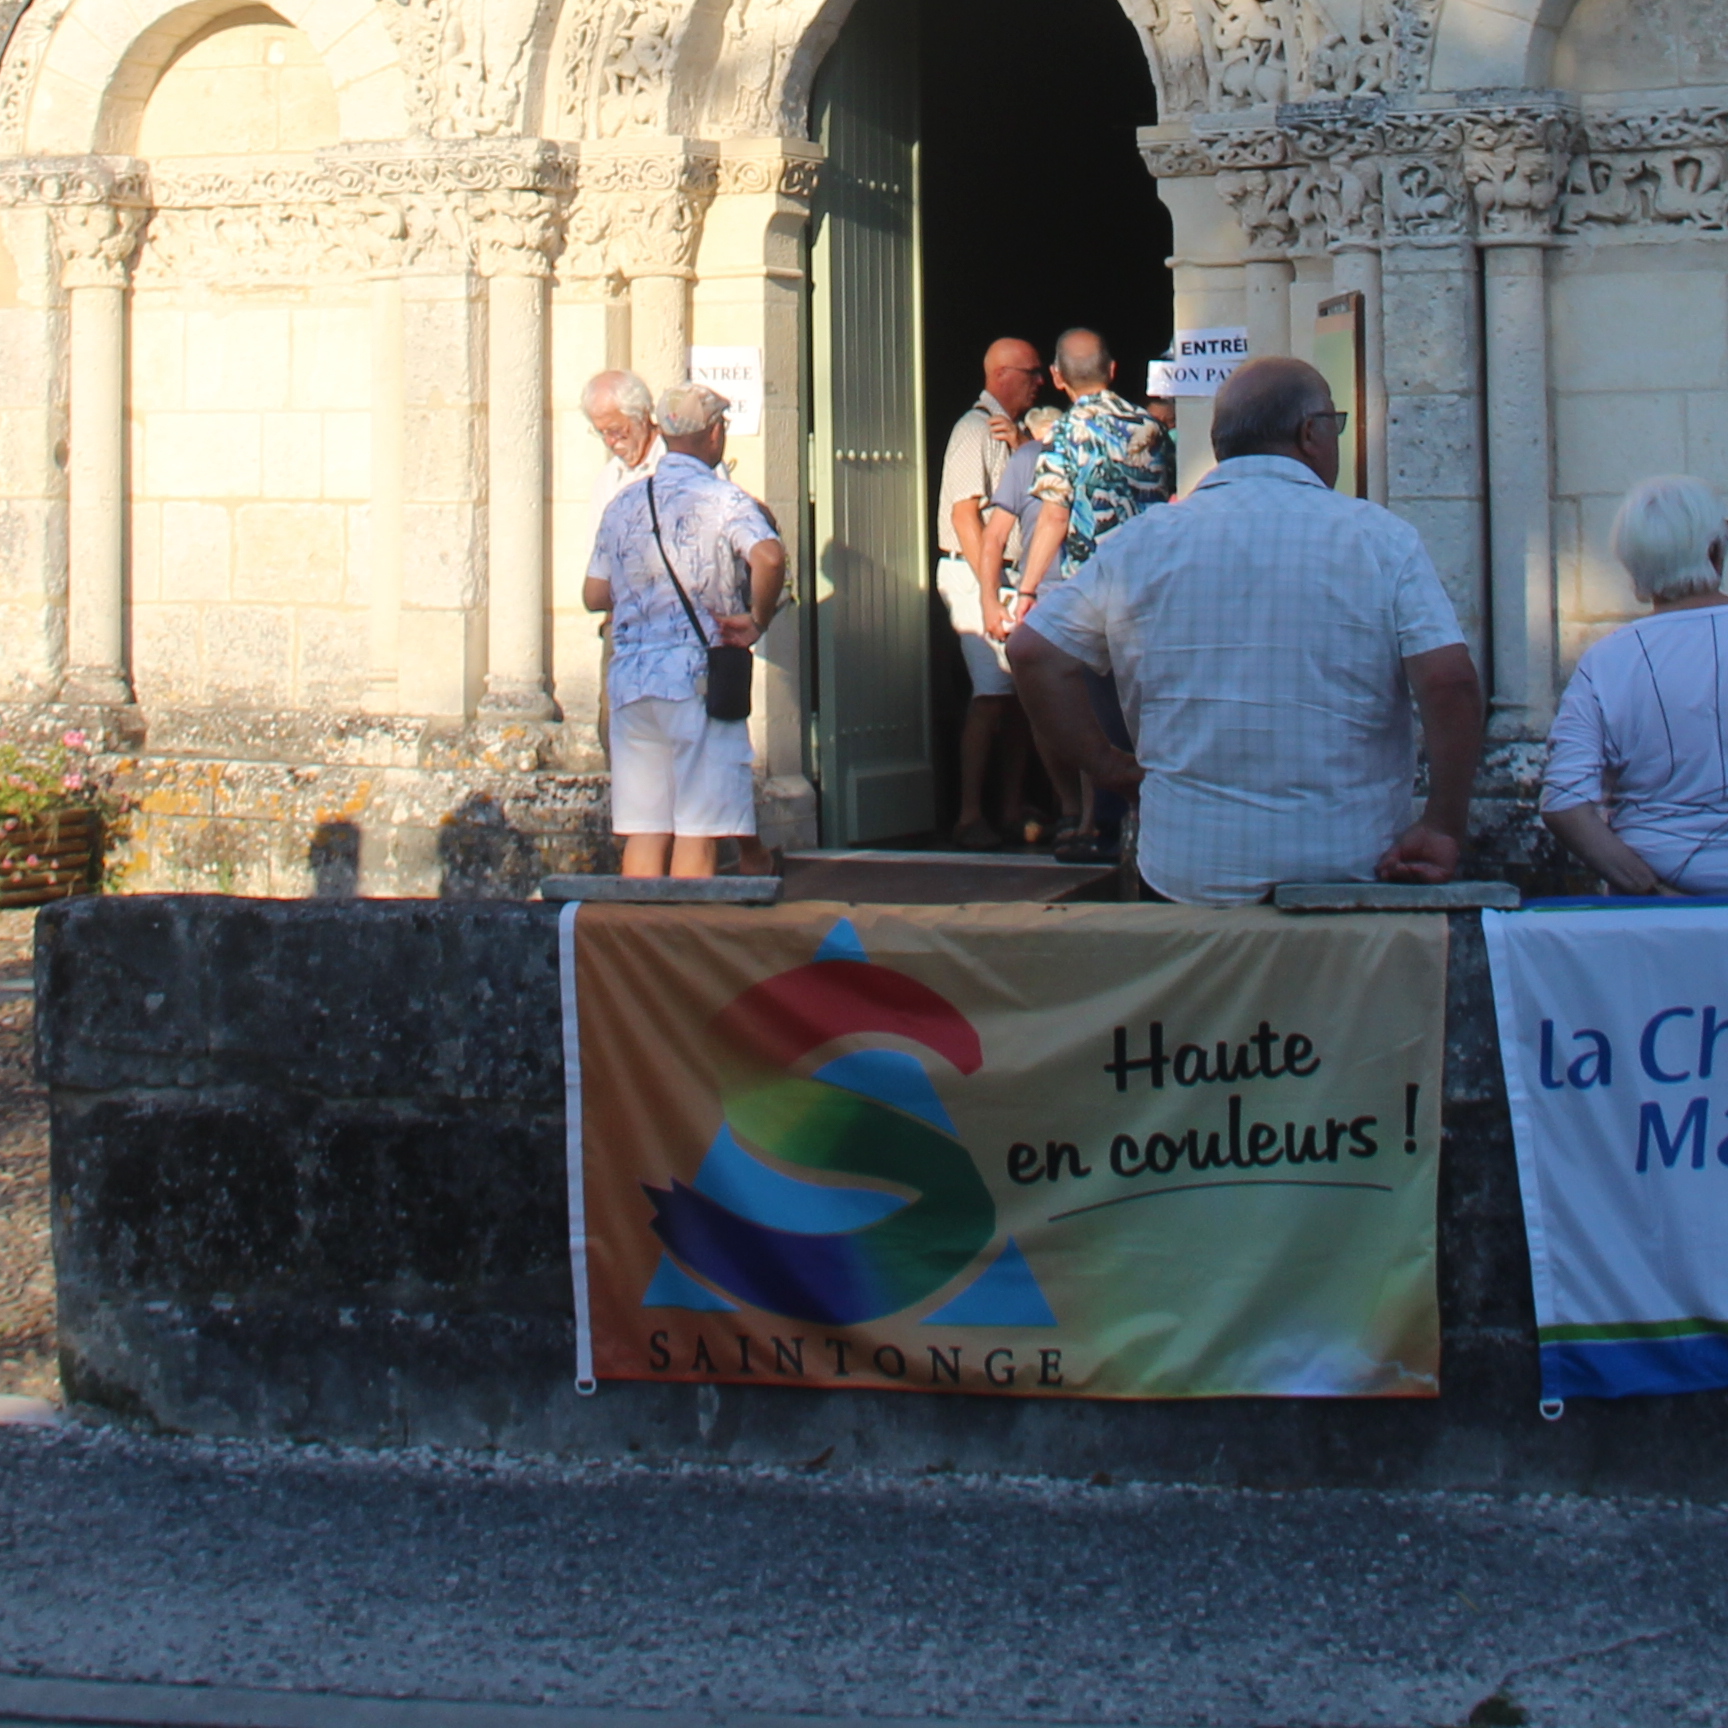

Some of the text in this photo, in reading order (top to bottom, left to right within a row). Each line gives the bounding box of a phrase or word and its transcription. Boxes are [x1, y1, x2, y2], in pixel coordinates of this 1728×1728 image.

[1162, 367, 1200, 383] NON
[1103, 1021, 1322, 1093] Haute
[1537, 1017, 1613, 1091] la
[1006, 1130, 1091, 1187] en
[1108, 1094, 1379, 1179] couleurs
[647, 1329, 1066, 1389] SAINTONGE
